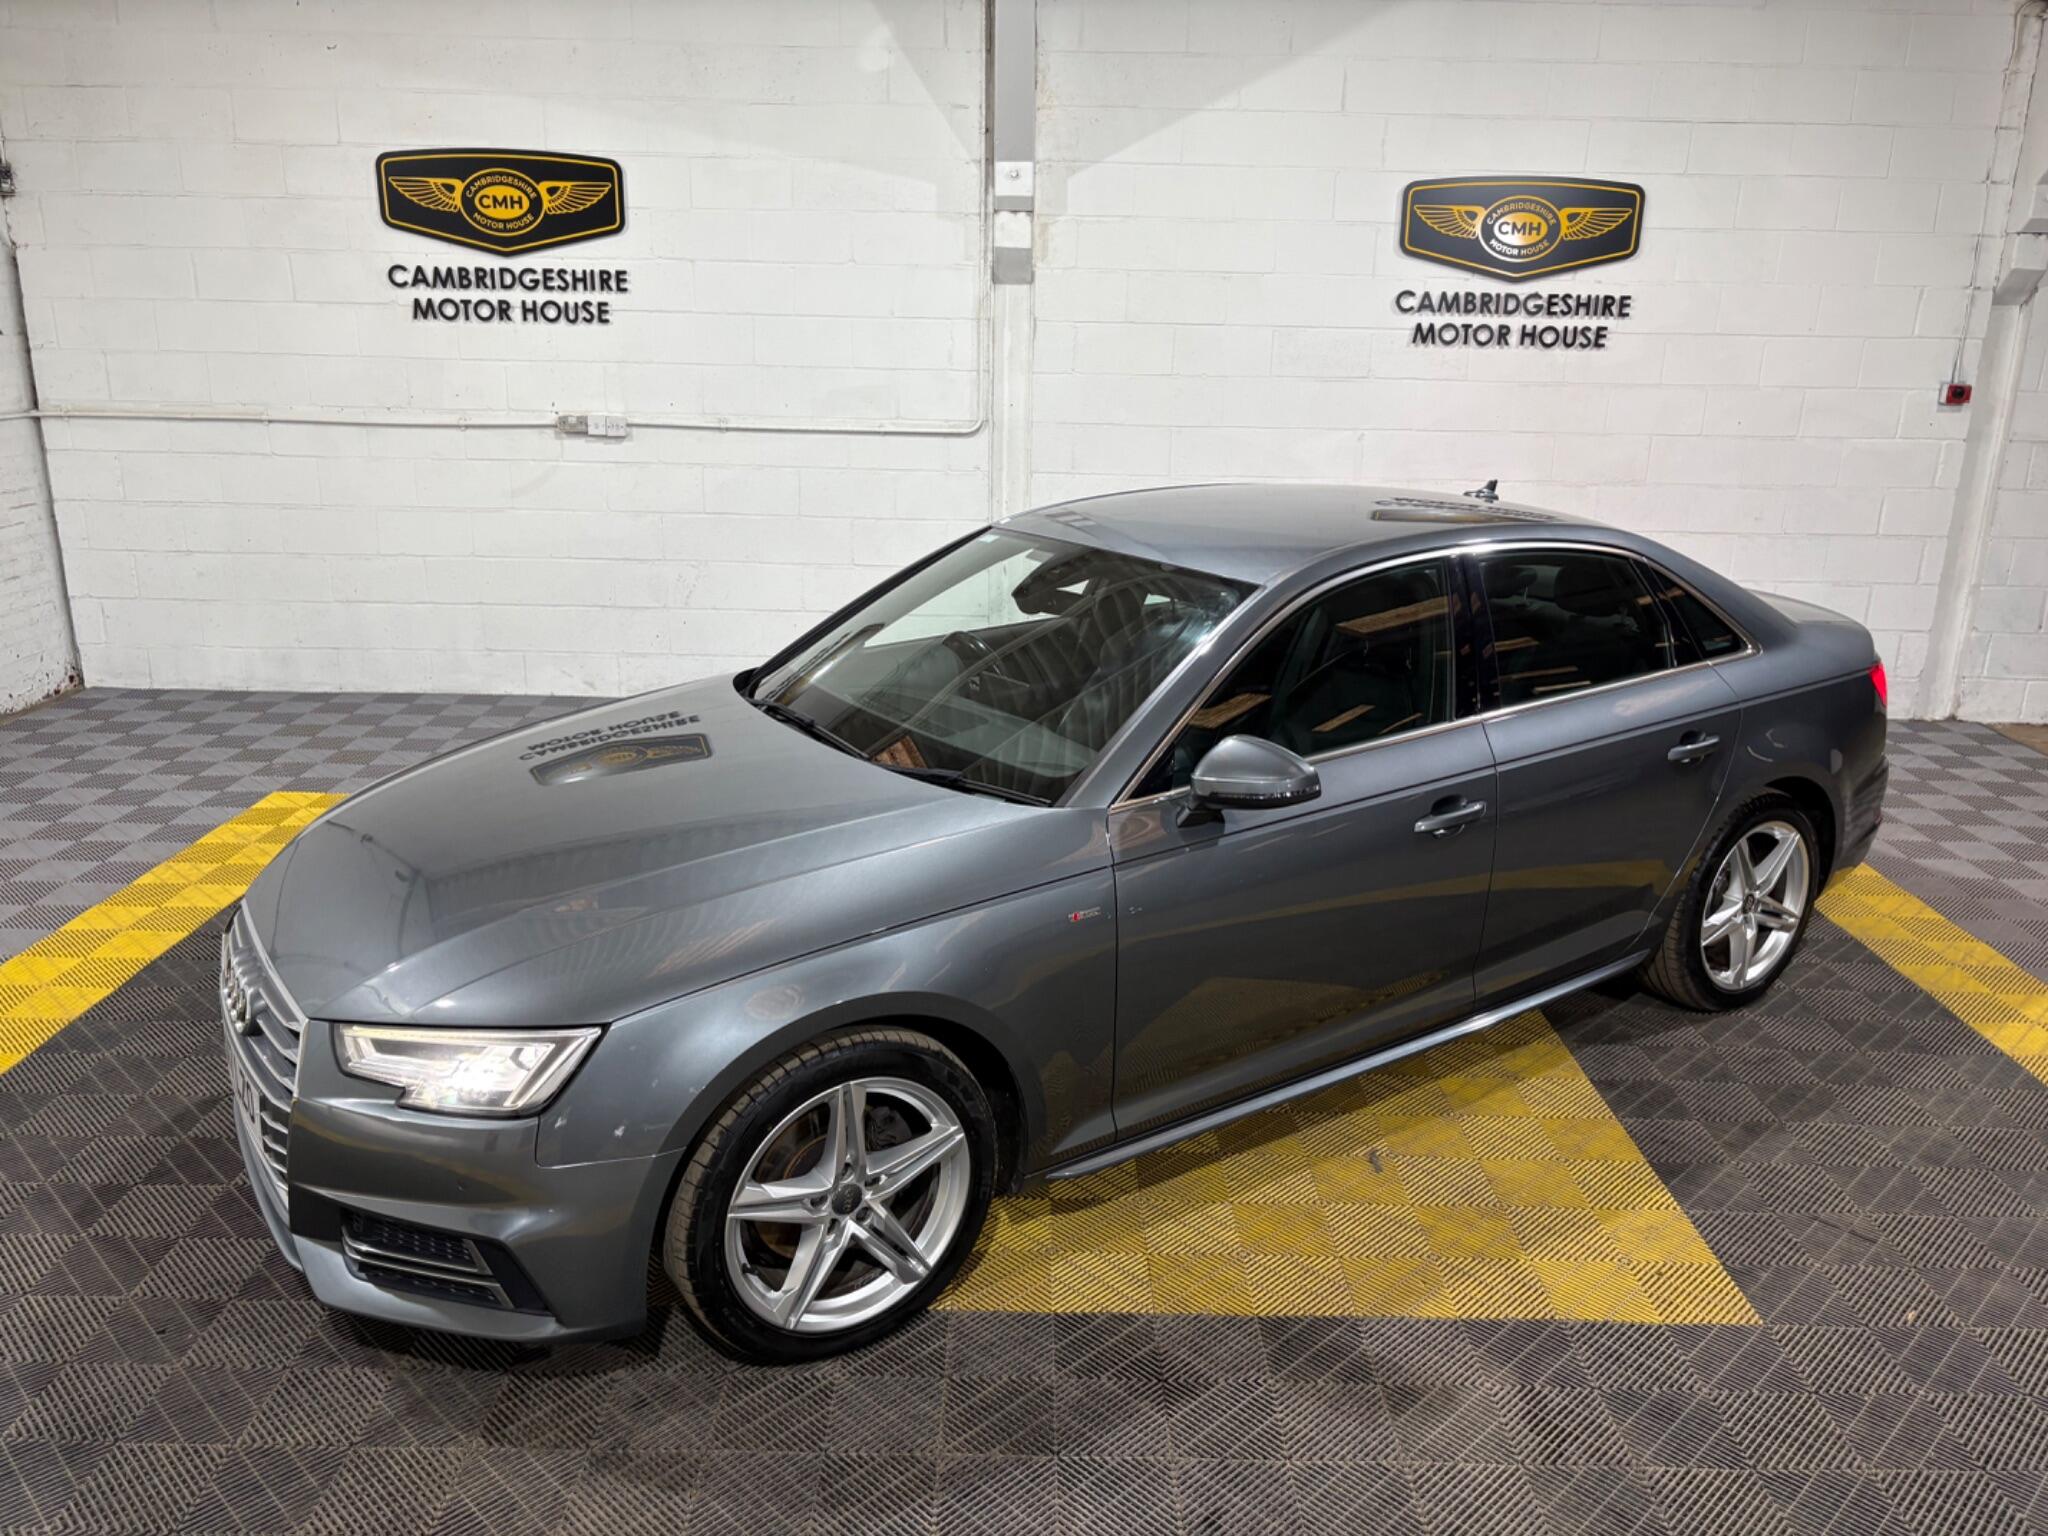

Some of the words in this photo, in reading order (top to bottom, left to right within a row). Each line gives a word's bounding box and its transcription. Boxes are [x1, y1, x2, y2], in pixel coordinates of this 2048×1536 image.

[465, 175, 537, 200] CAMBRIDGESHIRE
[478, 194, 523, 210] CMH
[1486, 202, 1557, 226] CAMBRIDGESHIRE
[473, 212, 504, 230] MOTOR
[505, 213, 535, 230] HOUSE
[1498, 221, 1542, 236] CMH
[1489, 238, 1519, 256] MOTOR
[1519, 239, 1550, 256] HOUSE
[387, 264, 629, 293] CAMBRIDGESHIRE
[413, 297, 512, 322] MOTOR
[522, 299, 611, 324] HOUSE
[1395, 289, 1632, 317] CAMBRIDGESHIRE
[1411, 322, 1511, 347] MOTOR
[1519, 324, 1609, 348] HOUSE
